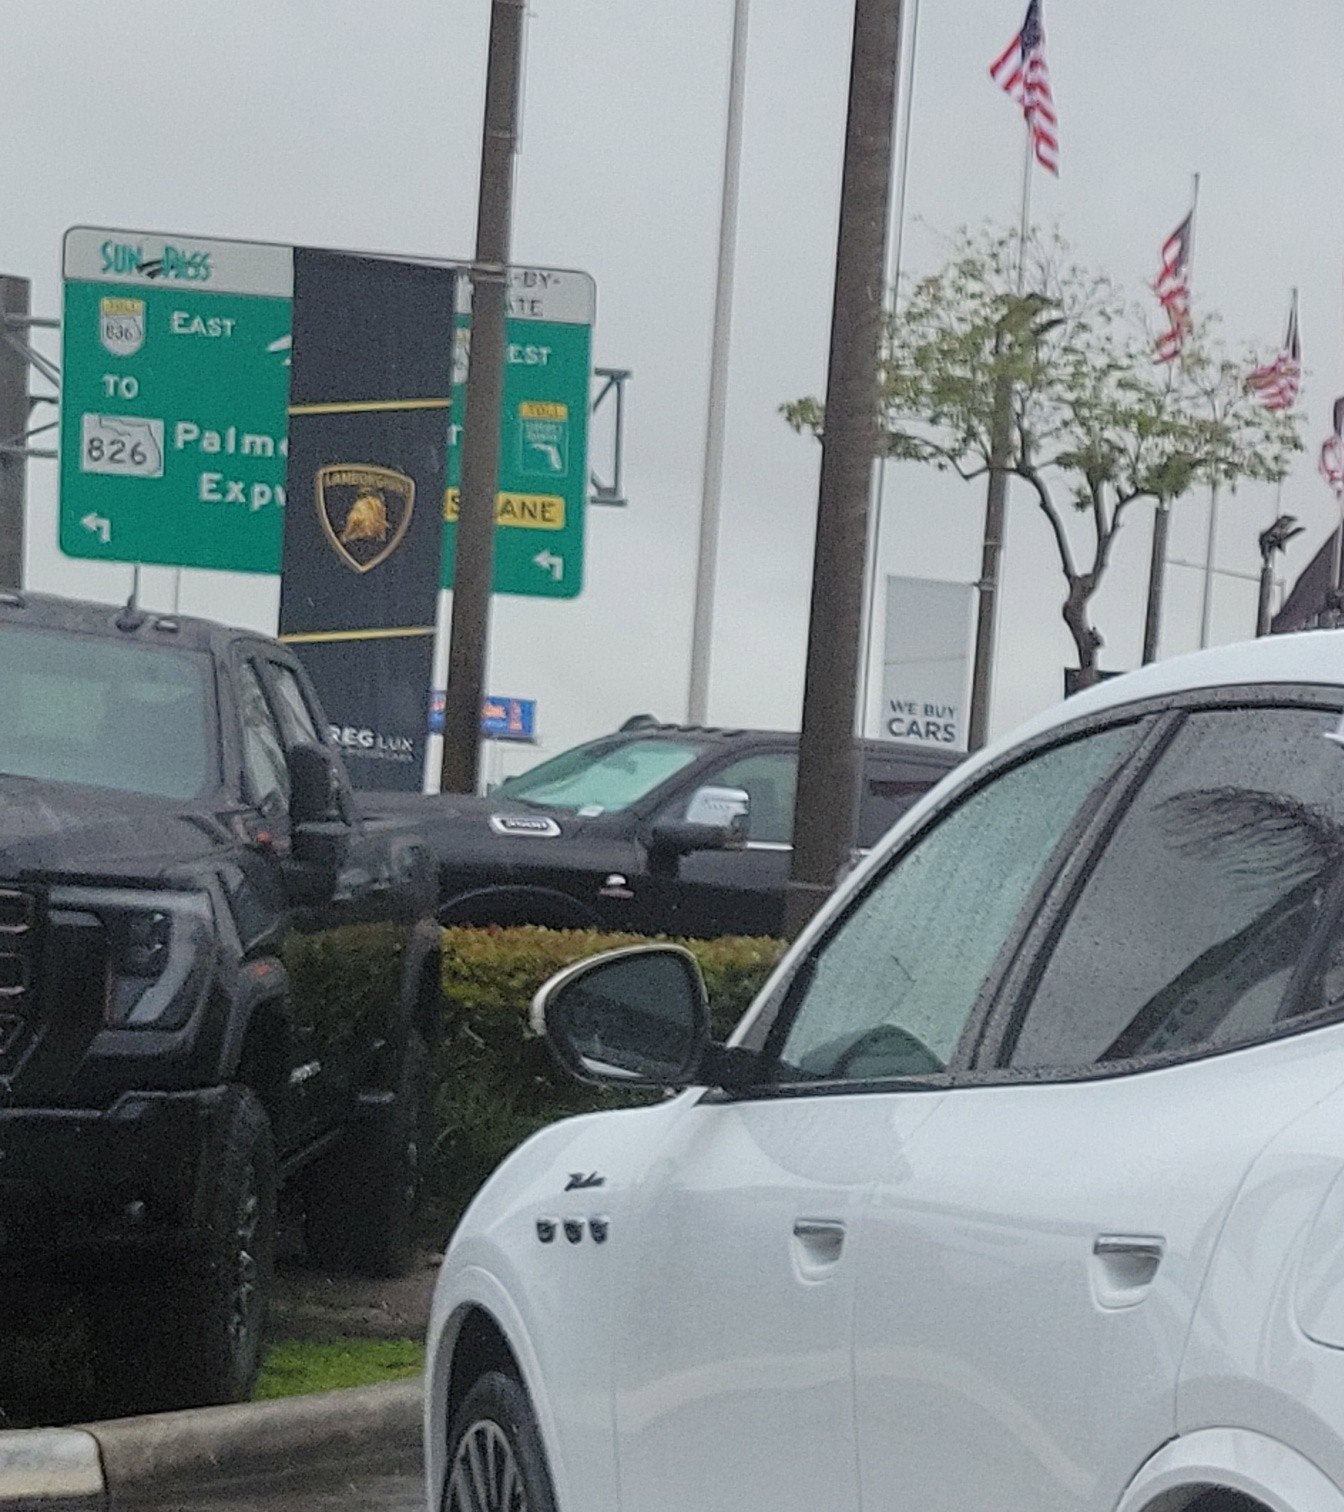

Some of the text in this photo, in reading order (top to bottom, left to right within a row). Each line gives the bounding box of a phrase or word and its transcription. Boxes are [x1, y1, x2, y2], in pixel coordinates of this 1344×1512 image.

[172, 310, 236, 338] EAST
[508, 343, 551, 366] EST
[102, 373, 139, 400] TO
[87, 436, 148, 466] 826
[500, 498, 557, 523] ANE
[890, 700, 955, 719] WE BUY
[887, 717, 956, 743] CARS
